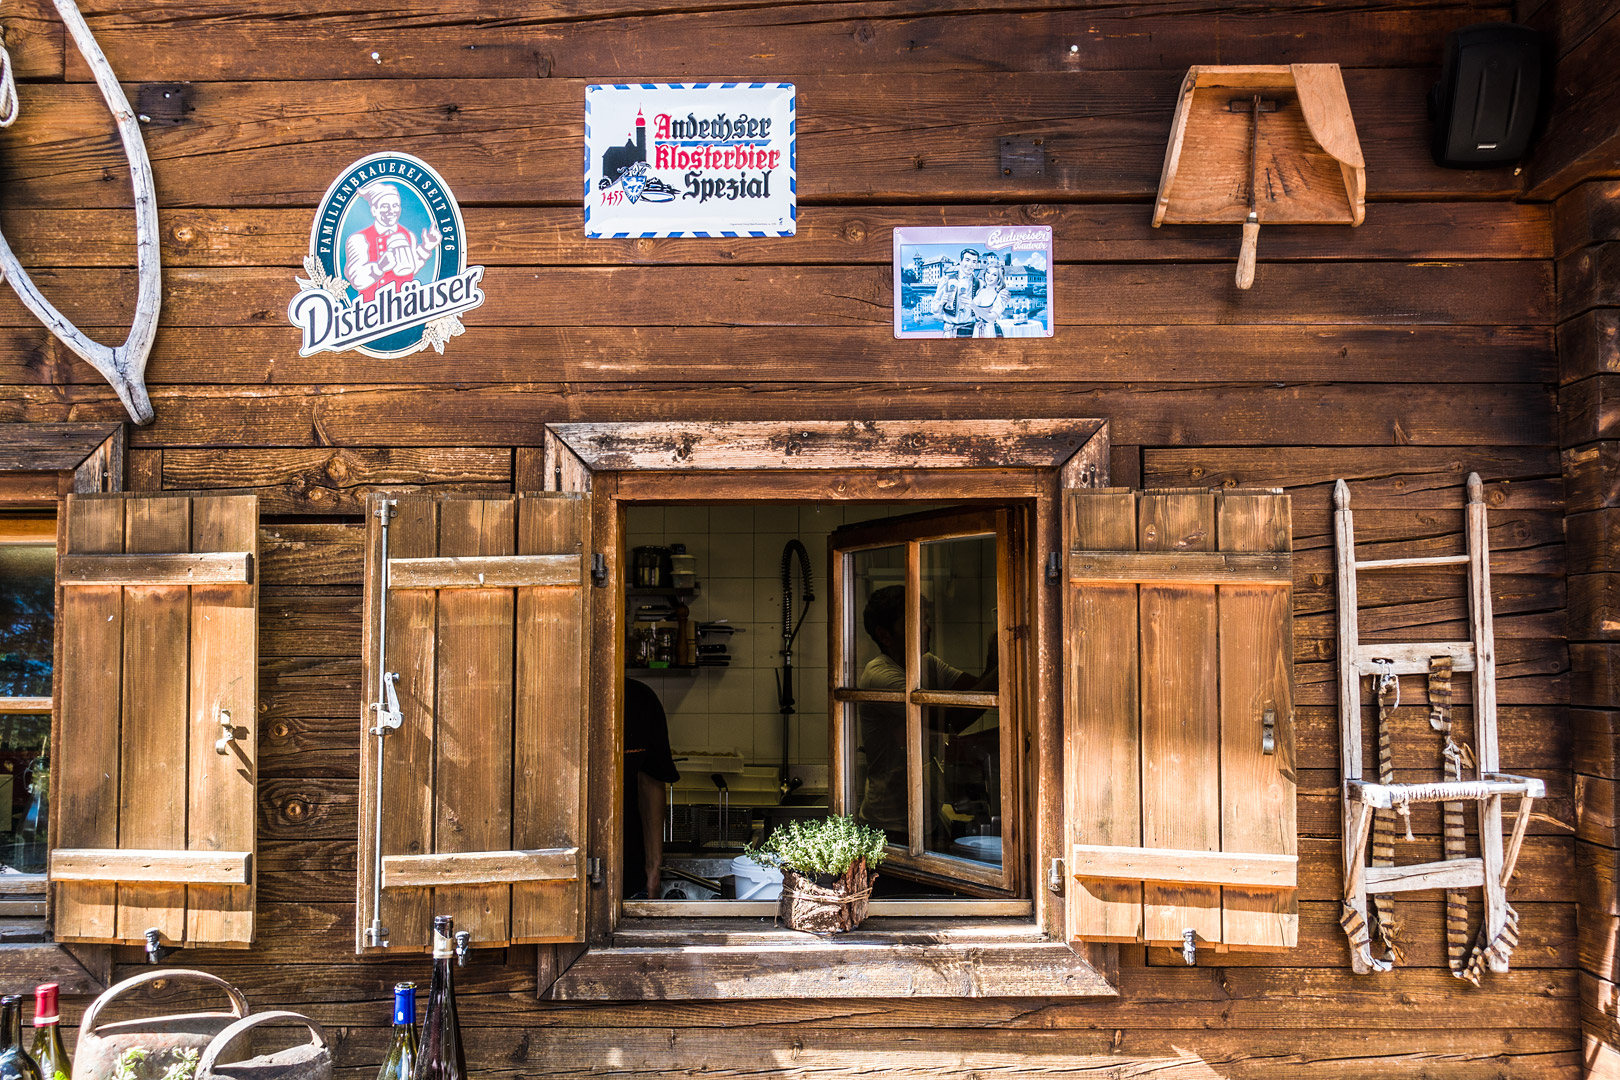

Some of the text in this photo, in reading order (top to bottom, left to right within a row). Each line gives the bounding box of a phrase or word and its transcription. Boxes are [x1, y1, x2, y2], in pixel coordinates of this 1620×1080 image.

[654, 112, 772, 142] Andechser
[654, 144, 780, 171] Klosterbier
[600, 190, 625, 207] 1455
[682, 171, 772, 204] Spezial
[321, 163, 455, 253] FAMILIENBRAUEREI SEIT 1876
[988, 230, 1046, 246] Budweiser
[295, 272, 479, 348] Distelhäuser
